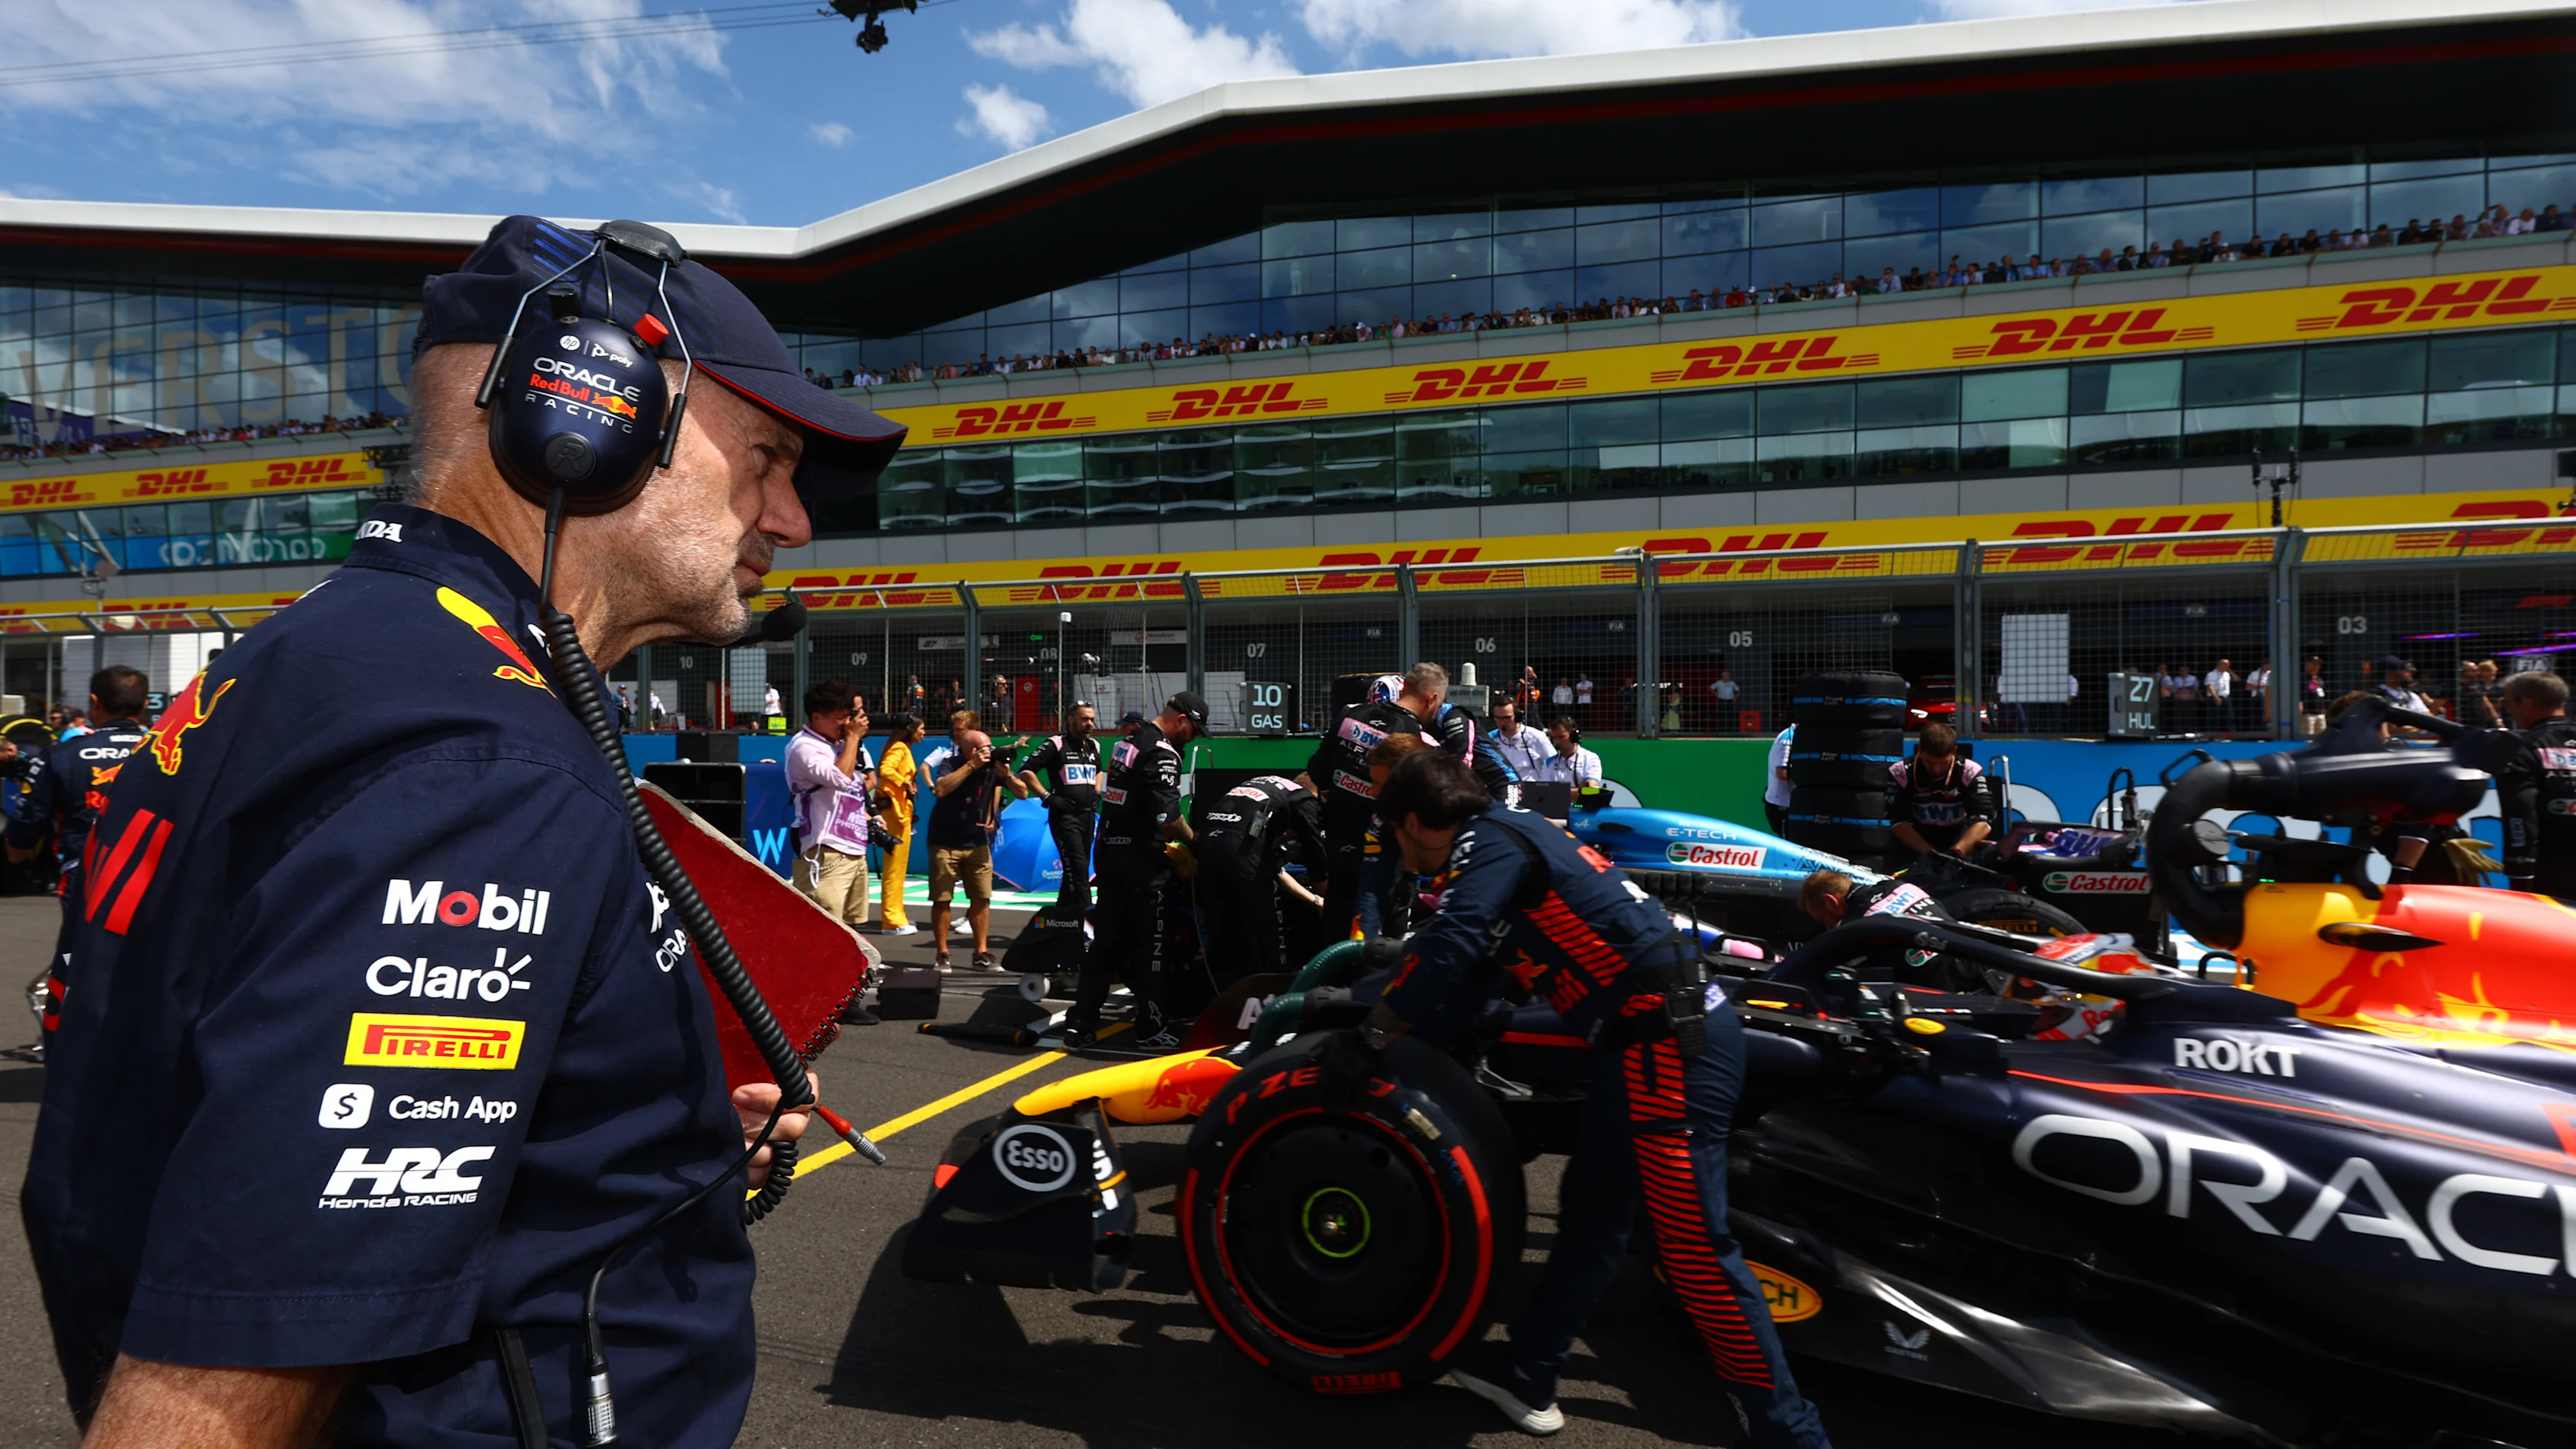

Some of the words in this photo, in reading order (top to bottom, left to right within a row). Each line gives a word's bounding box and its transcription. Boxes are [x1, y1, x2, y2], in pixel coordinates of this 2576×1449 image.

[2335, 275, 2552, 328] DHL
[1987, 308, 2177, 356] DHL
[560, 335, 580, 350] hp
[610, 353, 633, 368] poly
[1680, 336, 1848, 380] DHL
[533, 357, 641, 402] ORACLE
[1412, 361, 1558, 401] DHL
[525, 393, 633, 434] RACING
[1171, 383, 1303, 420] DHL
[955, 402, 1072, 436] DHL
[135, 470, 213, 494] DHL
[267, 459, 351, 485] DHL
[10, 481, 82, 504] DHL
[355, 519, 402, 542] NDA
[2006, 513, 2246, 564] DHL
[1639, 532, 1839, 577] DHL
[1317, 547, 1493, 589] DHL
[791, 573, 926, 608] DHL
[1038, 562, 1186, 599] DHL
[1608, 621, 1624, 630] FIA
[2338, 616, 2368, 635] 03
[1247, 642, 1266, 658] 07
[1475, 638, 1496, 653] 06
[1728, 630, 1753, 647] 05
[680, 656, 693, 668] 10
[851, 652, 867, 665] 09
[1040, 647, 1058, 660] 08
[2517, 658, 2547, 671] FIA
[1253, 685, 1282, 706] 10
[2129, 676, 2155, 702] 27
[147, 694, 163, 709] 3
[1251, 714, 1283, 728] GAS
[2129, 712, 2155, 729] HUL
[1359, 731, 1384, 747] BW
[79, 748, 131, 759] ORA
[1228, 788, 1264, 798] astrol
[1666, 827, 1737, 841] E-TECH
[1690, 845, 1759, 867] Castrol
[2069, 874, 2151, 891] Castrol
[382, 879, 550, 935] Mobil
[1885, 892, 1915, 914] BWT
[1046, 918, 1079, 929] Microsoft
[1152, 891, 1165, 971] ALPINE
[655, 929, 690, 973] ORA
[365, 953, 516, 1002] Claro
[362, 1024, 511, 1059] PIRELLI
[2174, 1037, 2300, 1078] ROKT
[389, 1094, 459, 1119] Cash
[464, 1096, 517, 1124] App
[322, 1146, 496, 1195] HRC
[318, 1196, 401, 1209] Honda
[404, 1192, 478, 1207] RACING
[2012, 1114, 2576, 1278] ORAC
[1310, 1371, 1403, 1394] PIRELLI
